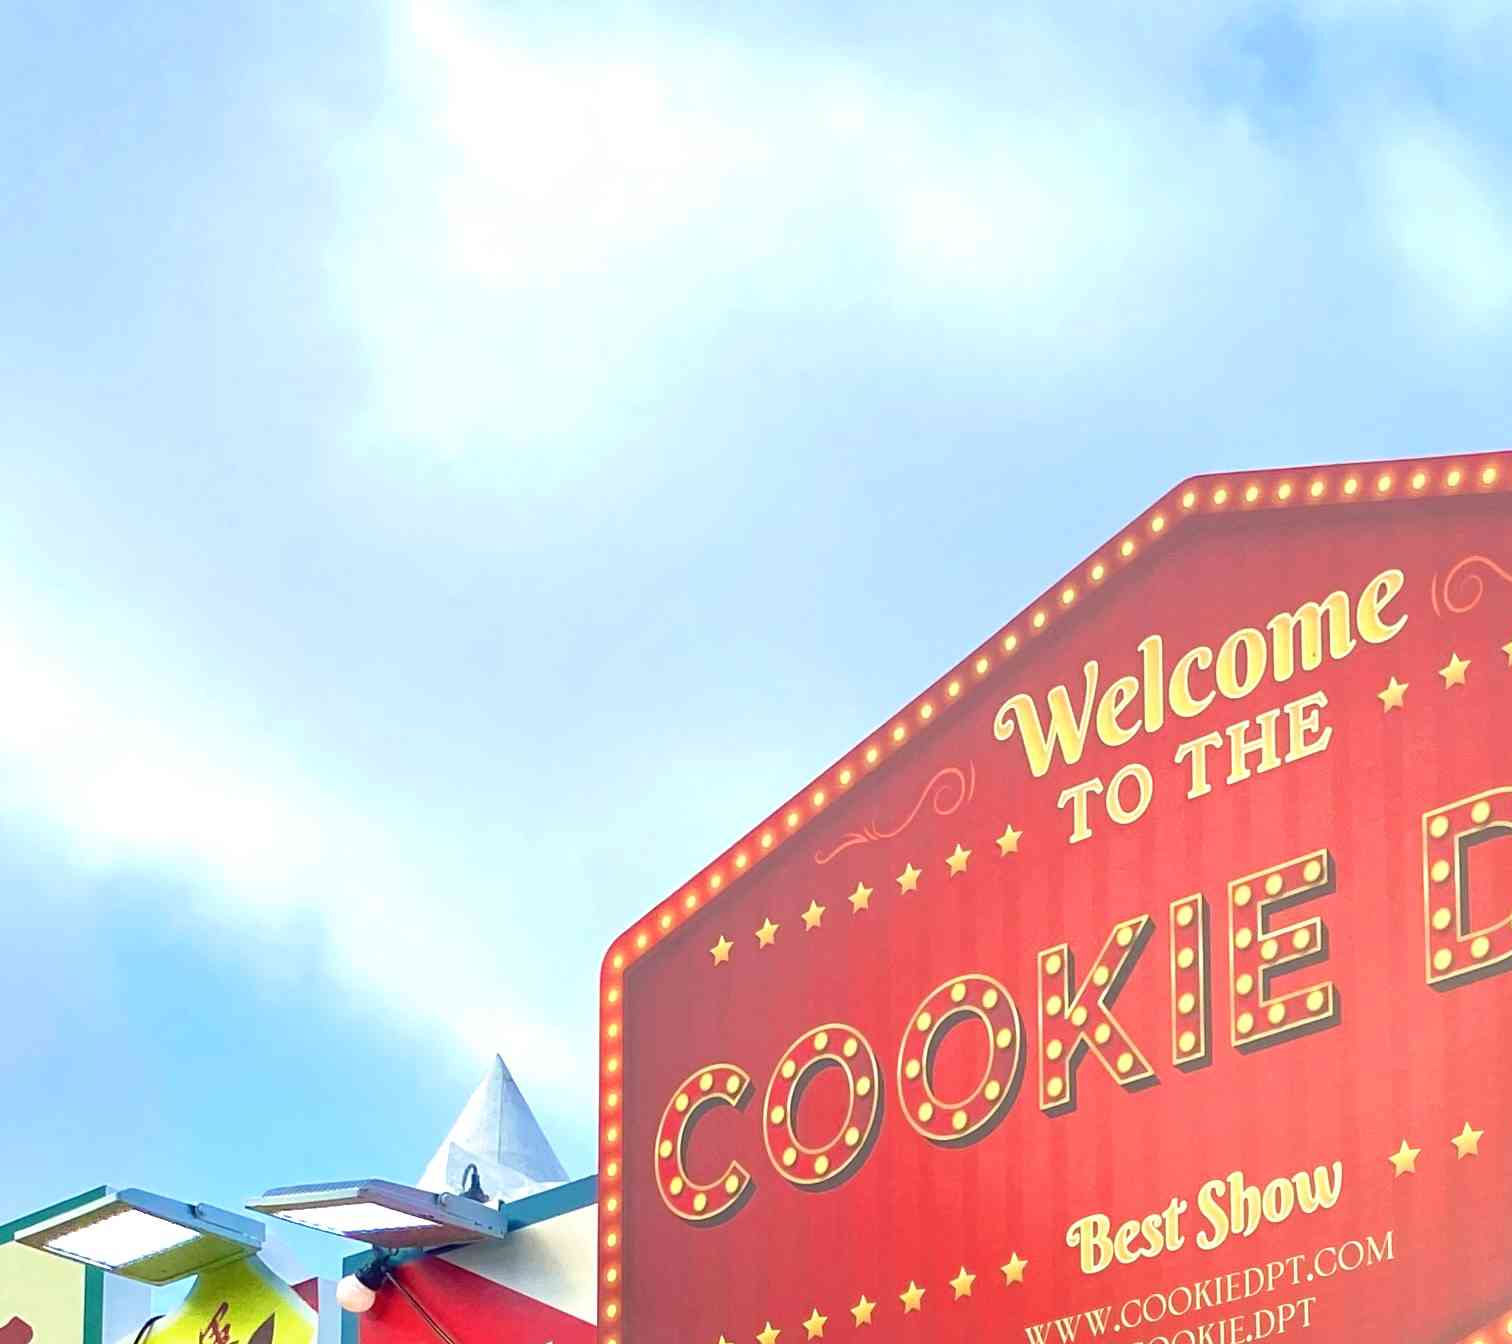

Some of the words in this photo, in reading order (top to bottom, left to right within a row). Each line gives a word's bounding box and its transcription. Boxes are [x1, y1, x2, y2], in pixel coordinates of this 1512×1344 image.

[993, 569, 1409, 778] Welcome
[1058, 763, 1153, 844] TO
[1175, 691, 1334, 800] THE
[654, 849, 1338, 1226] COOKIE
[1066, 1200, 1186, 1276] Best
[1196, 1162, 1343, 1251] Show
